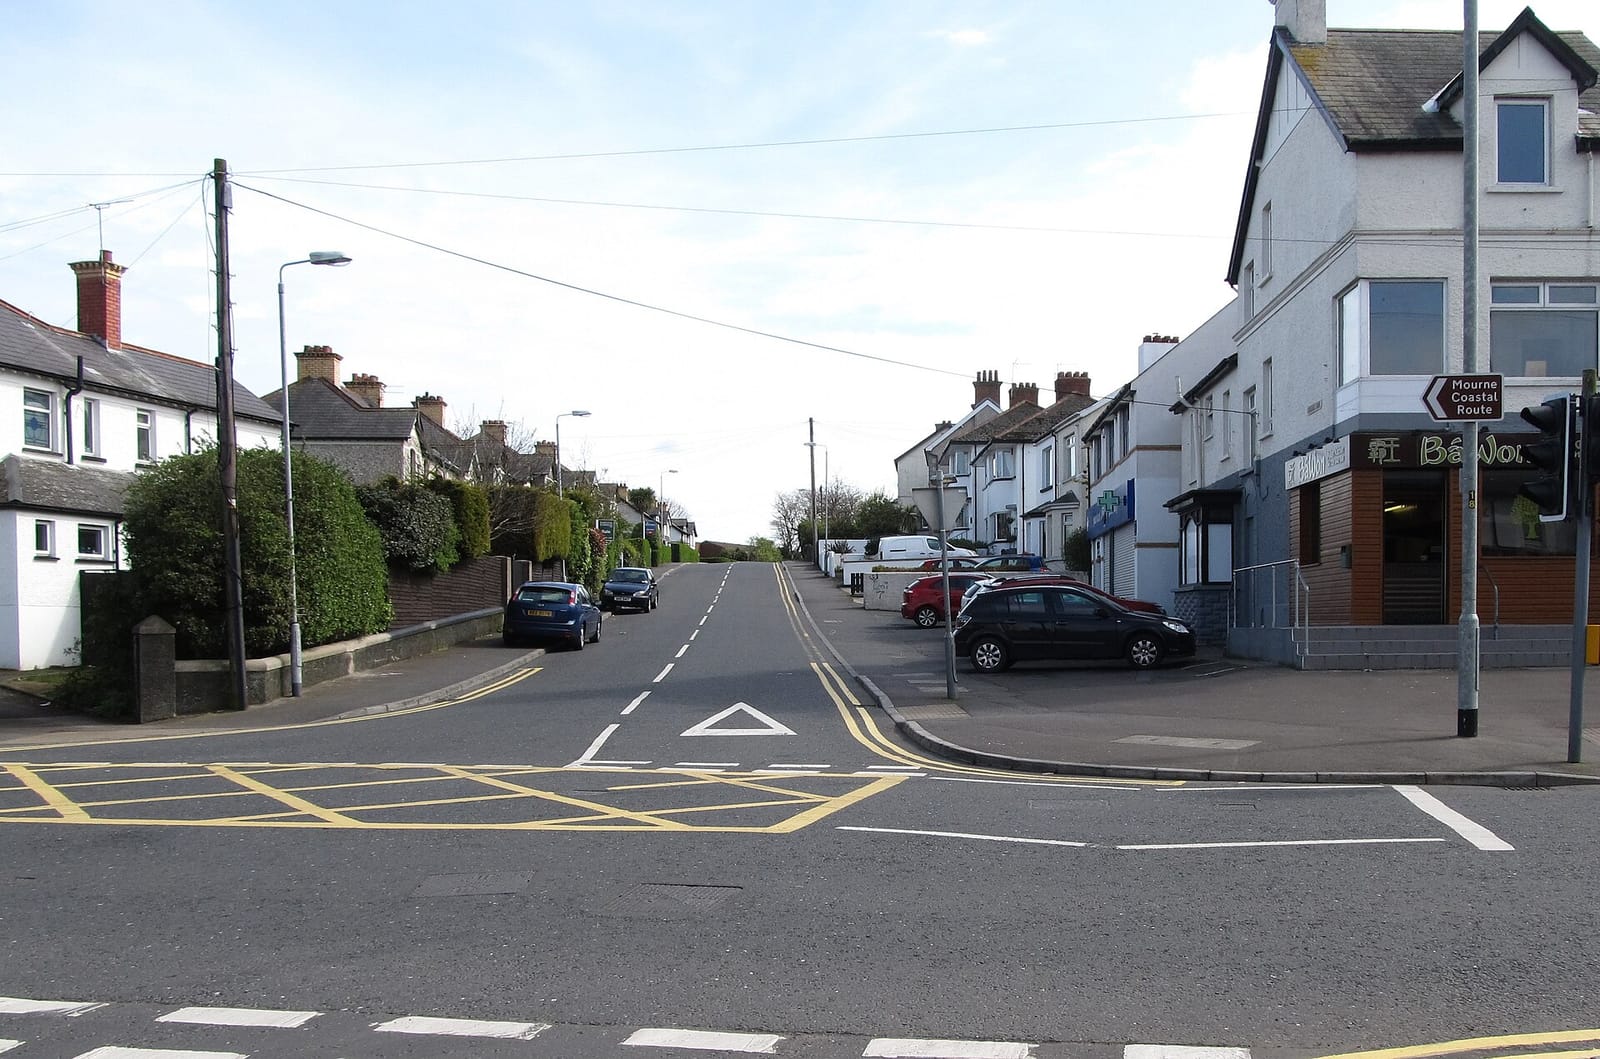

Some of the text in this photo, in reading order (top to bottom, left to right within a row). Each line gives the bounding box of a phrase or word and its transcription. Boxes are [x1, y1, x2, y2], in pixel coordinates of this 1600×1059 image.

[1452, 379, 1498, 390] Mourne
[1451, 391, 1498, 403] Coastal
[1457, 404, 1493, 415] Route
